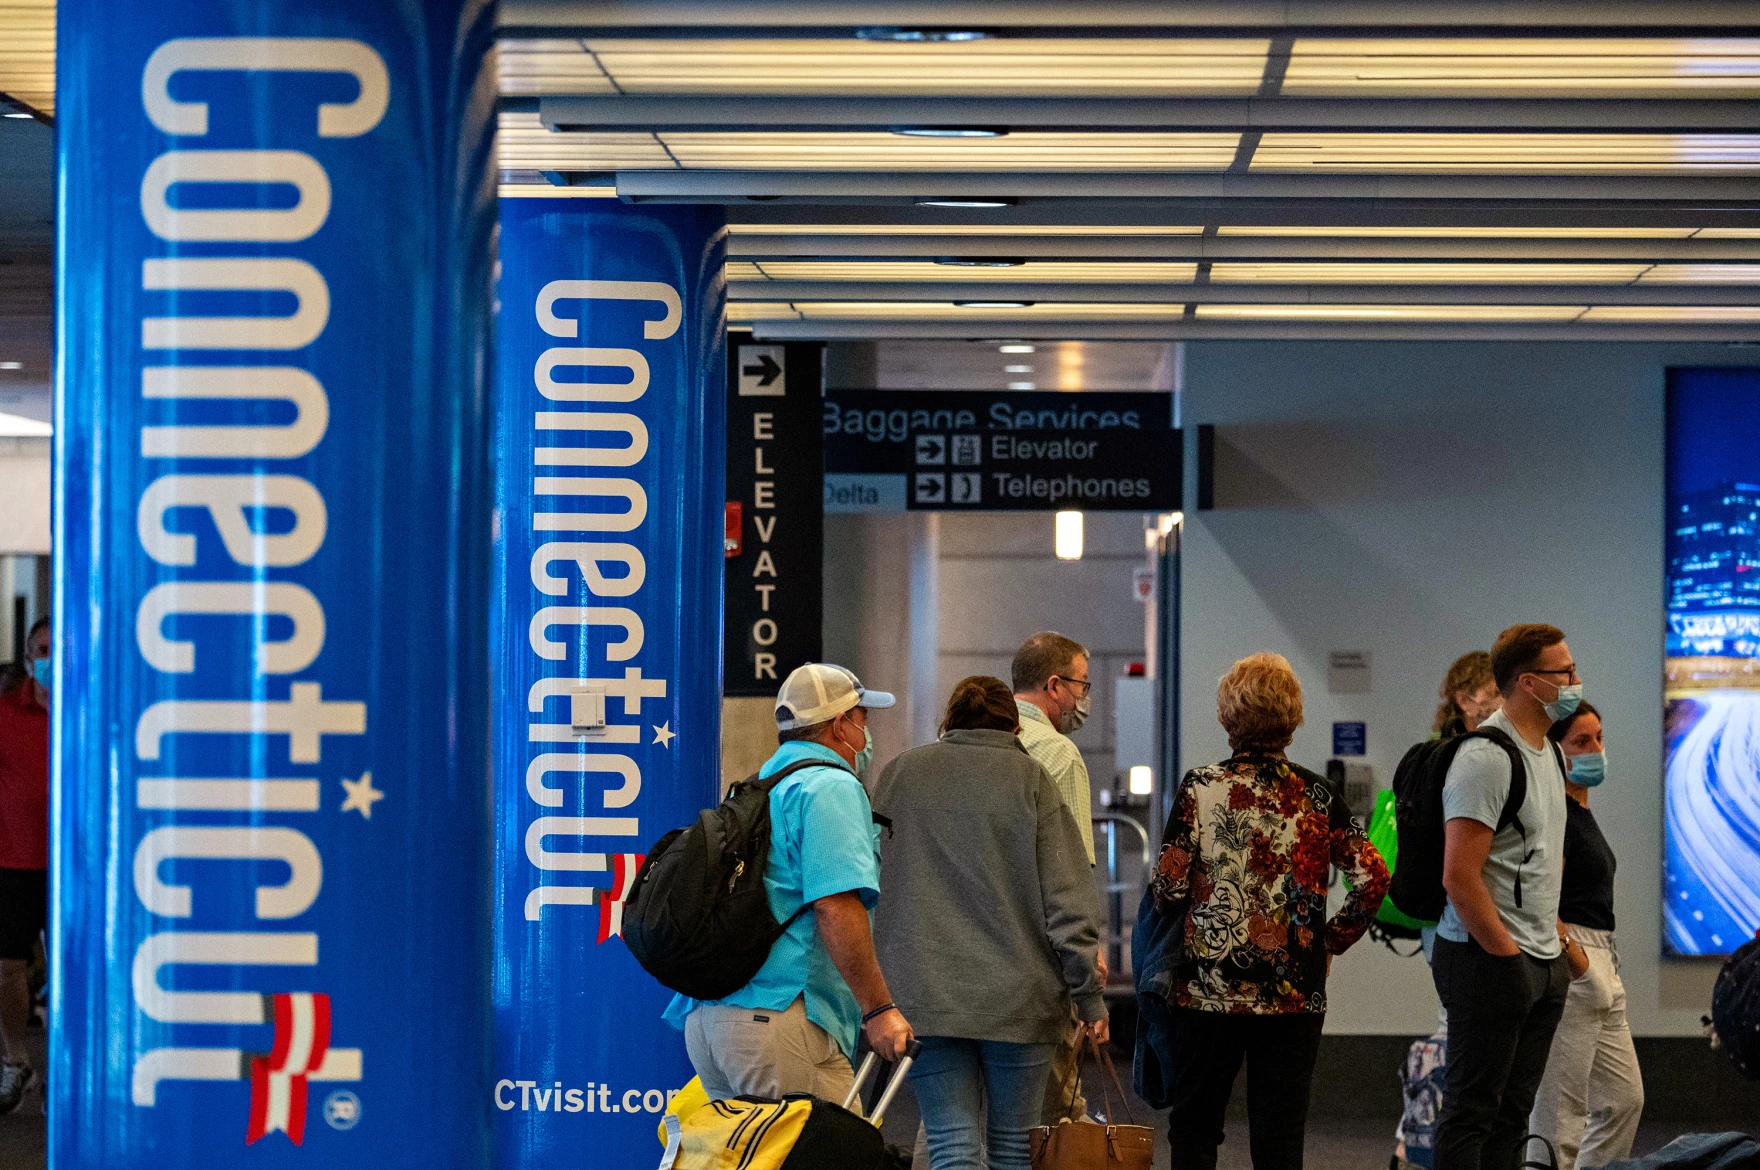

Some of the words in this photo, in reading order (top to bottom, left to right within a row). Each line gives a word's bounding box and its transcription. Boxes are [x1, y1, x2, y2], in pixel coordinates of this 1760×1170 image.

[988, 402, 1142, 429] Services
[991, 434, 1098, 460] Elevator
[991, 472, 1151, 503] Telephones
[752, 412, 778, 681] ELEVATOR
[131, 36, 391, 1107] Connecticut
